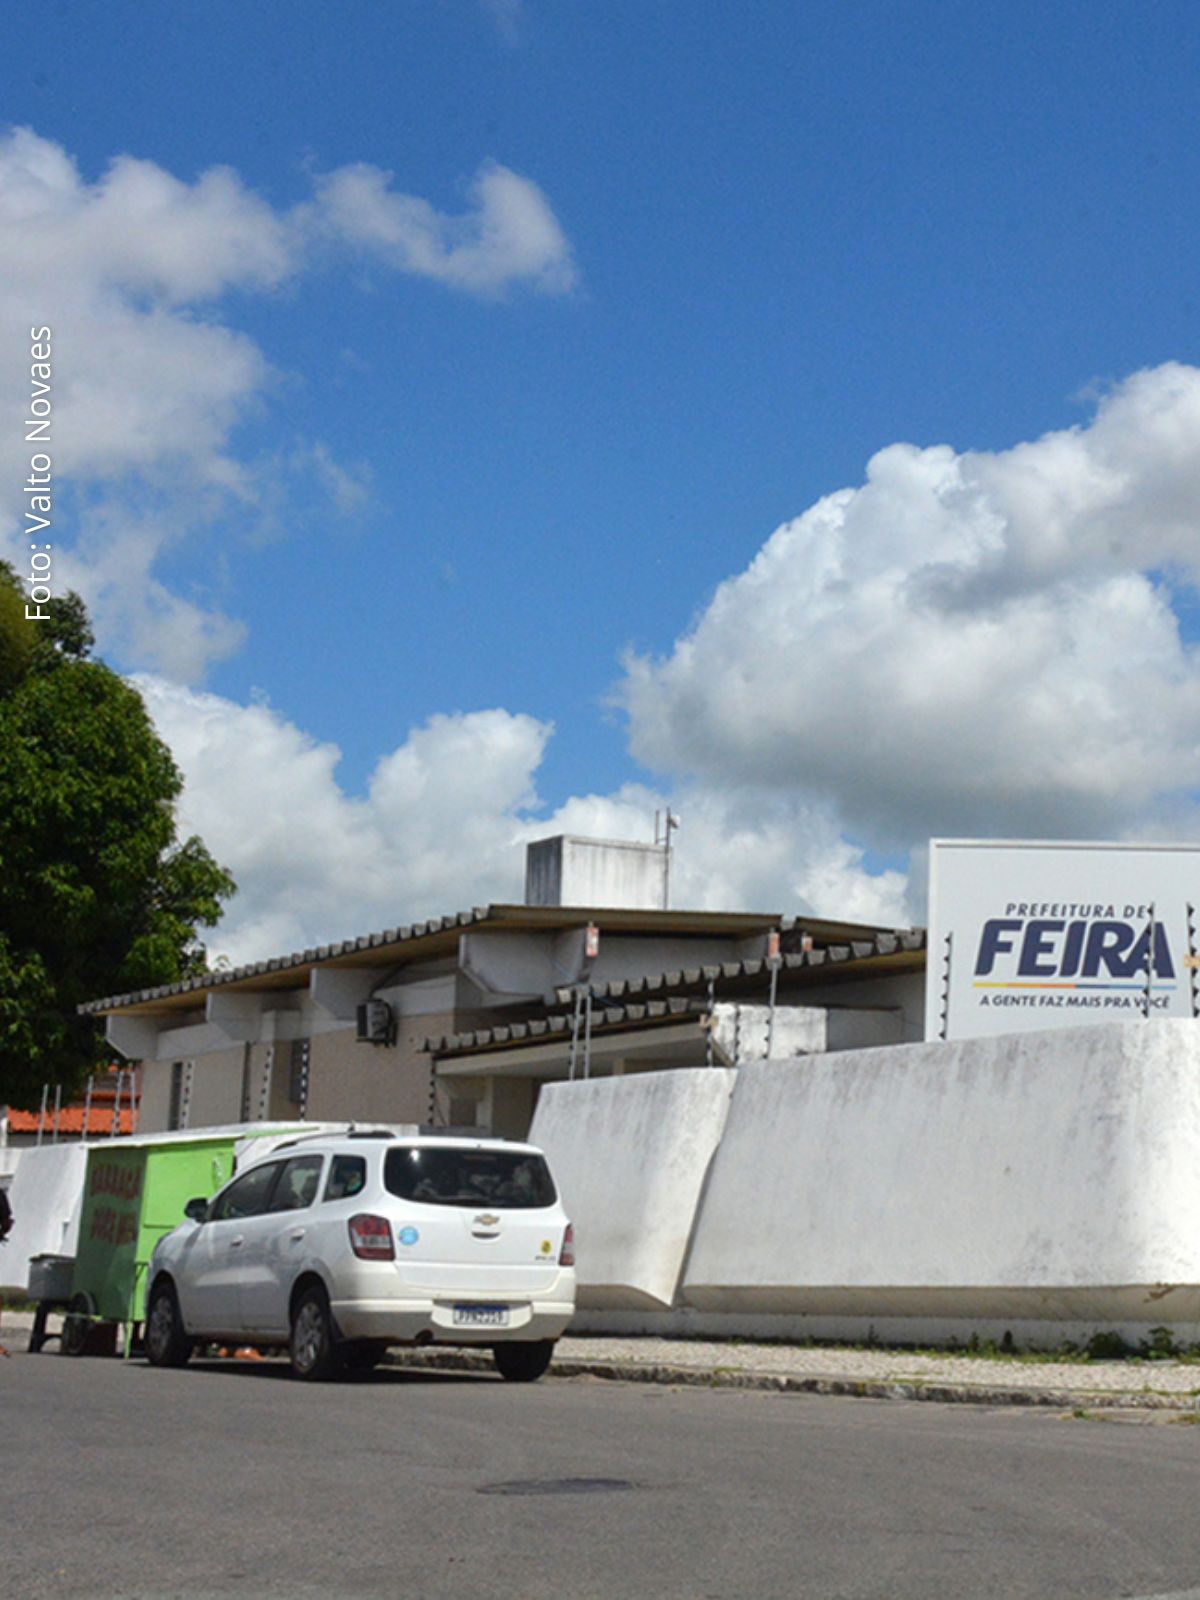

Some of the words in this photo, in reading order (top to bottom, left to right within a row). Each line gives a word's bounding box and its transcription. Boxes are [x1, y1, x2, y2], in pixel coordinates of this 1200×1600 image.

[1005, 903, 1115, 918] PREFEITURA
[1122, 905, 1147, 919] DE
[974, 918, 1176, 978] FEIRA
[979, 995, 990, 1006] A
[992, 995, 1038, 1007] GENTE
[1038, 996, 1065, 1007] FAZ
[1065, 996, 1101, 1008] MAIS
[1104, 997, 1131, 1008] PRA
